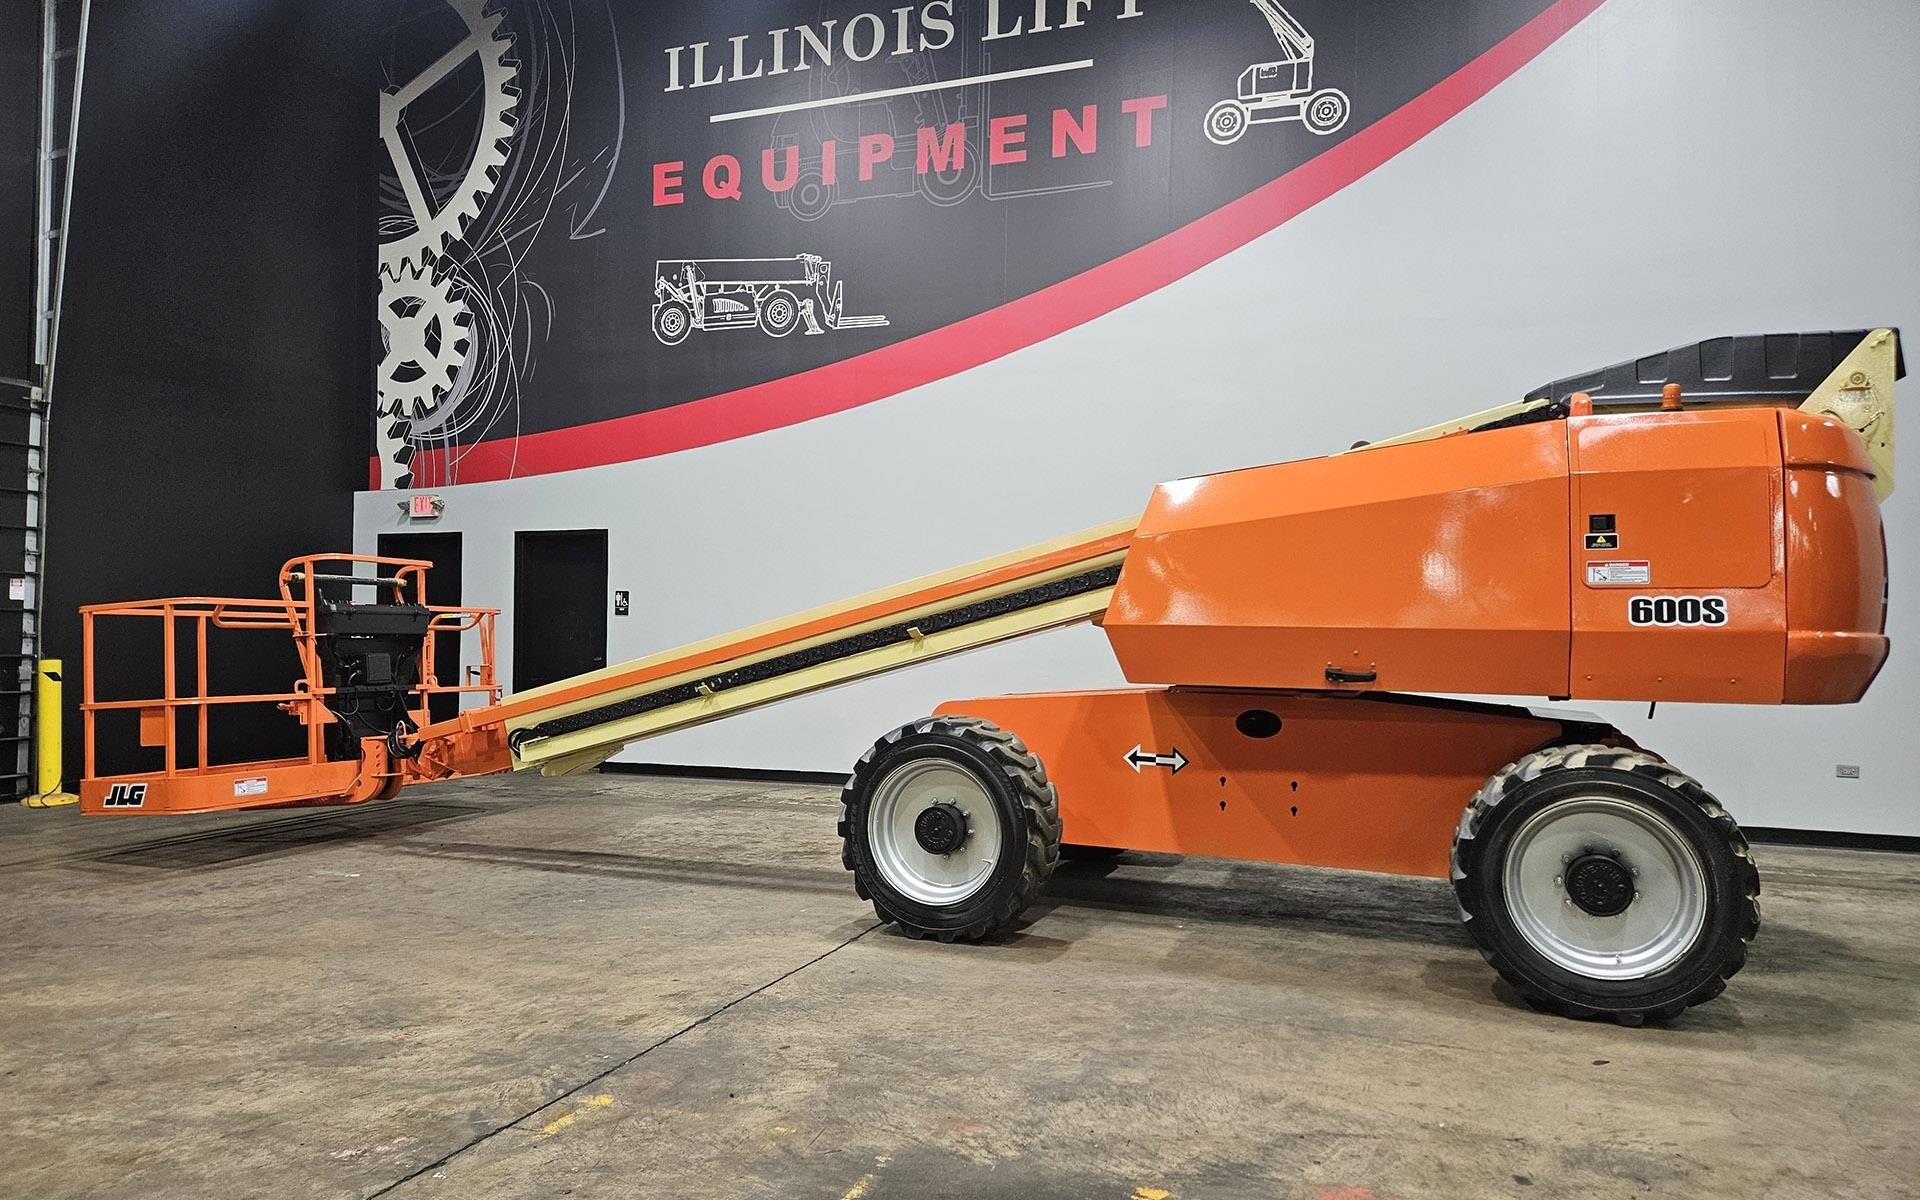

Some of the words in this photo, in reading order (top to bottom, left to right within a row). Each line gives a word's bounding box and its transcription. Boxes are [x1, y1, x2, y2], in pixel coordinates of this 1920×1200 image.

[663, 0, 955, 92] ILLINOIS
[652, 95, 1167, 206] EQUIPMENT
[413, 495, 433, 513] EXIT
[1630, 597, 1726, 625] 600S
[104, 784, 146, 806] JLG
